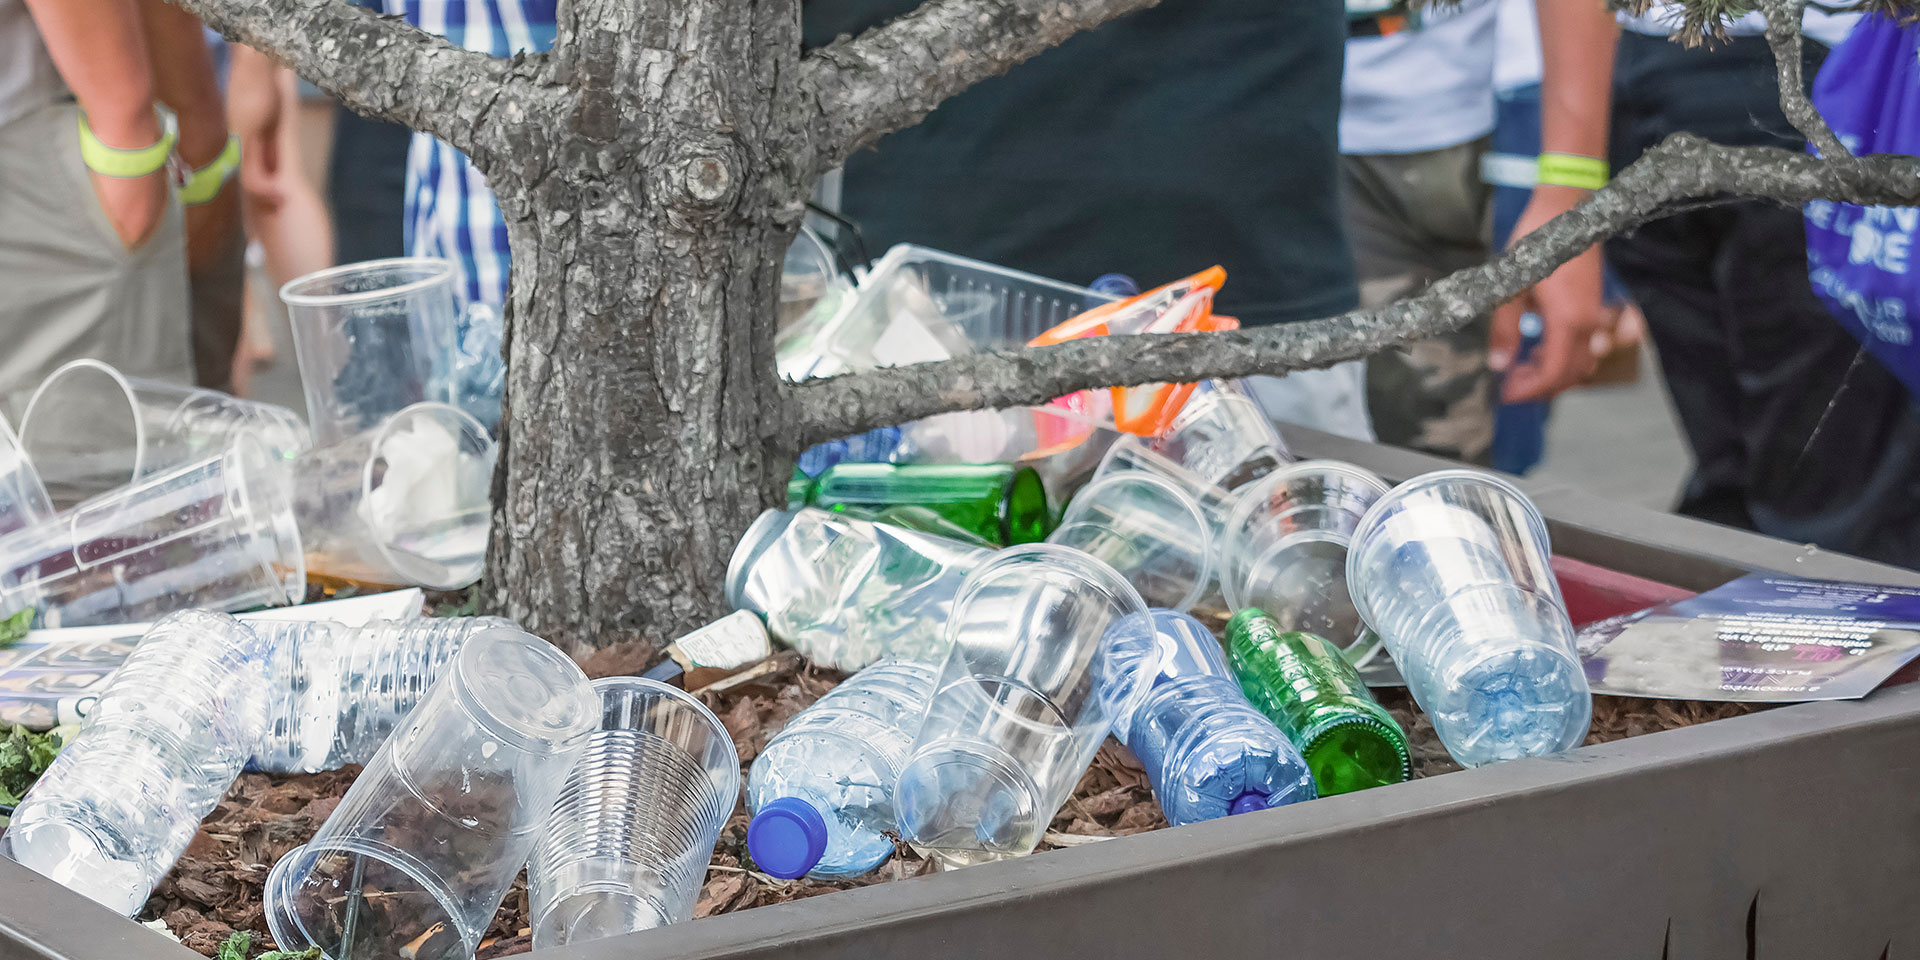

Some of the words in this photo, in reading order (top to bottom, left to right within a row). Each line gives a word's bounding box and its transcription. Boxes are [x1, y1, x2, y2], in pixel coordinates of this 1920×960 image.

[1740, 634, 1754, 642] la
[1753, 635, 1772, 643] de
[1817, 639, 1873, 648] endroits
